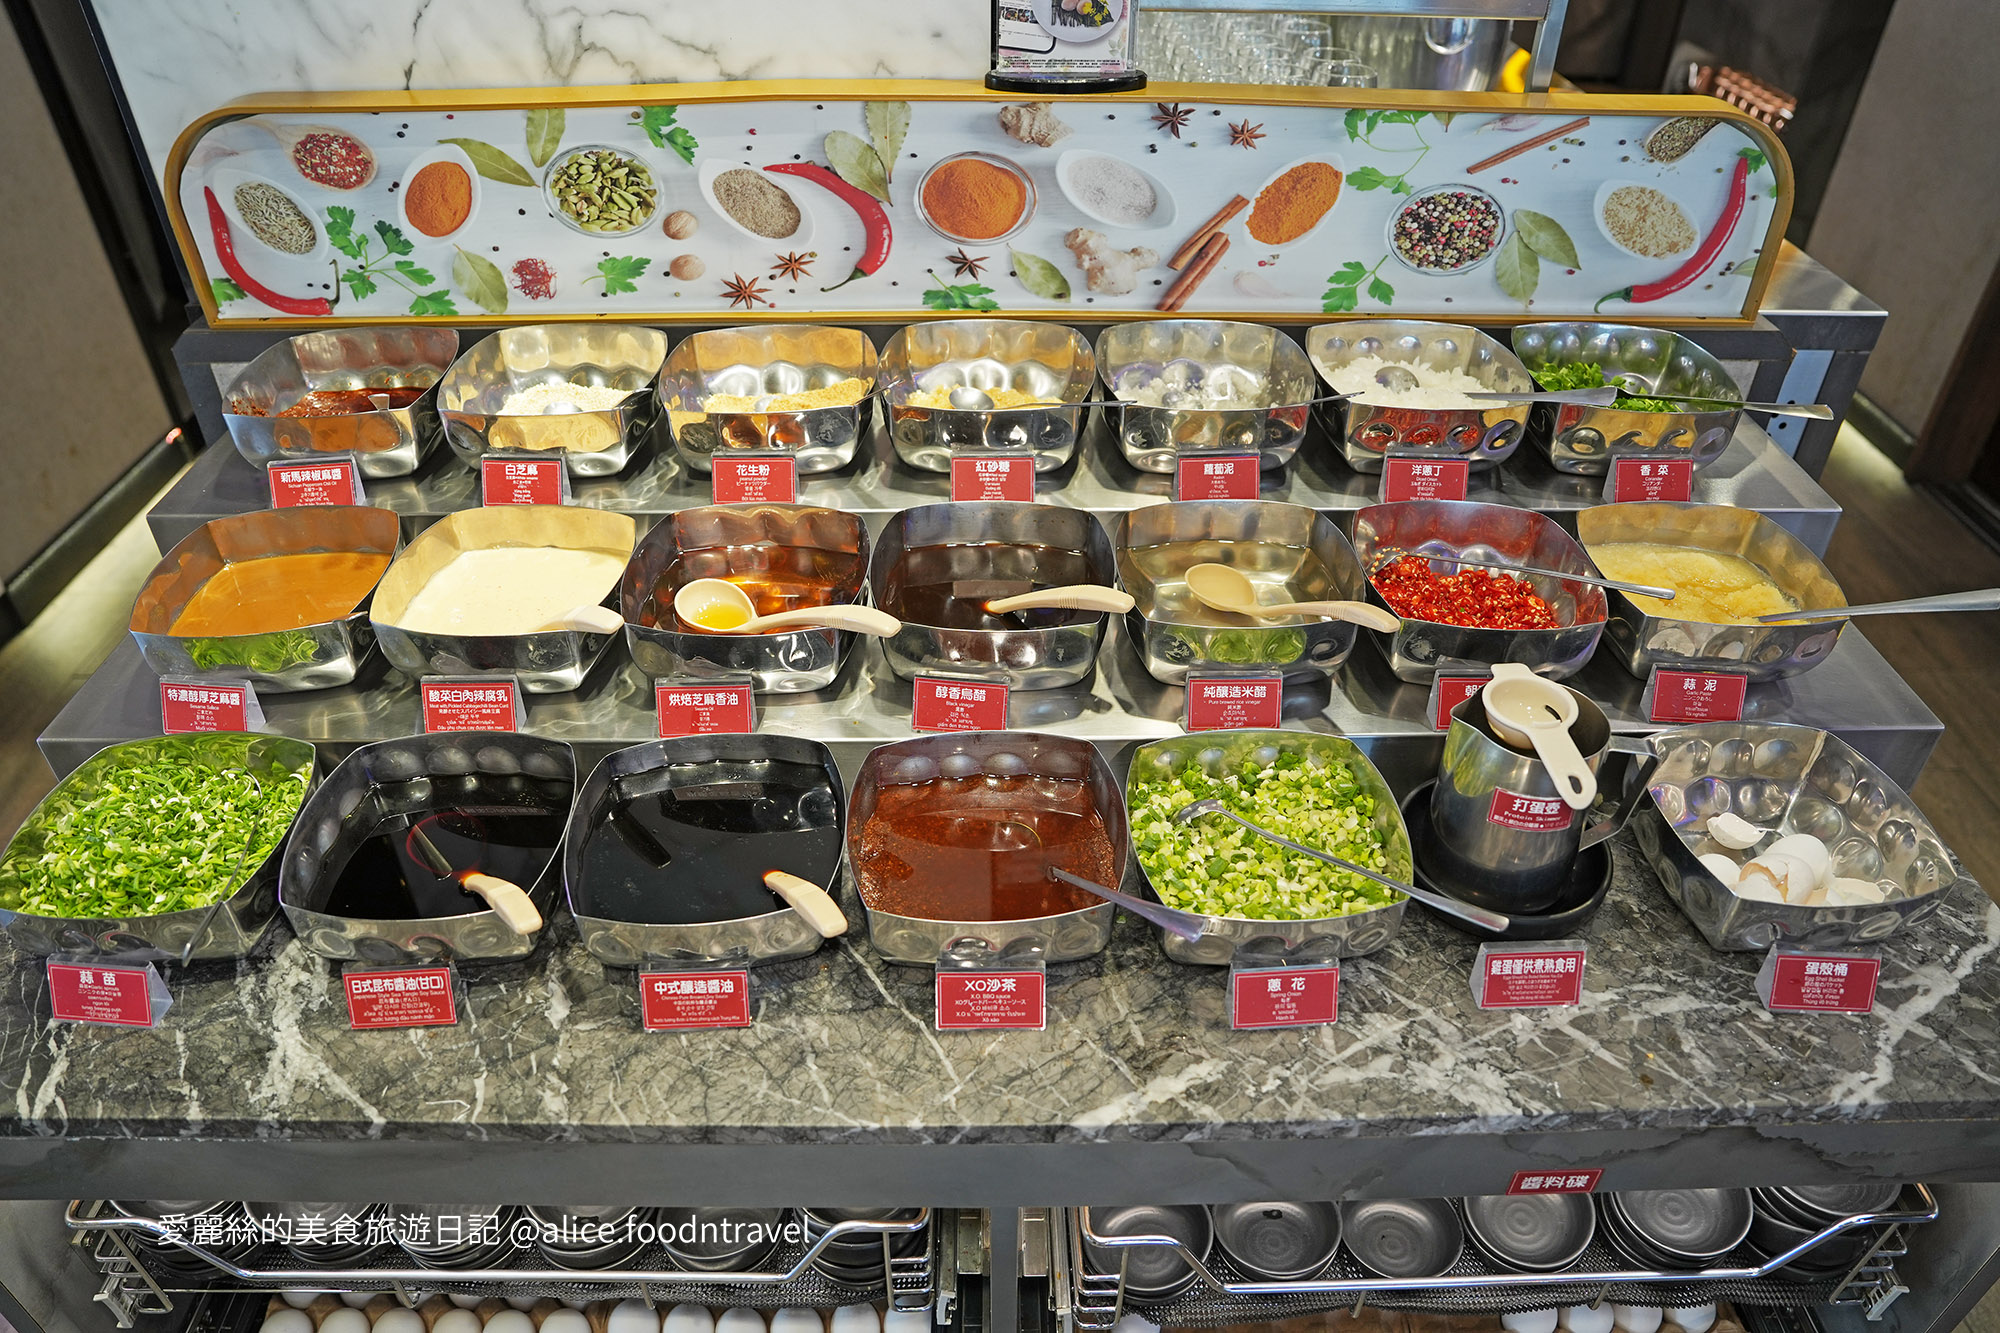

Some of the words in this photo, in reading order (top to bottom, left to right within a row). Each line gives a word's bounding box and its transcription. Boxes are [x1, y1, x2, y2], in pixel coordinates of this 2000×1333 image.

[505, 464, 538, 476] 白芝麻
[736, 464, 770, 476] 花生粉
[975, 460, 1010, 473] 紅砂糖
[1203, 463, 1234, 475] 蘿蔔泥
[1640, 464, 1669, 476] 香菜
[280, 468, 342, 483] 新馬辣椒麻醬
[1203, 685, 1267, 698] 純釀造米醋
[1683, 678, 1717, 691] 蒜泥
[167, 688, 240, 705] 特濃醇厚芝麻醬
[428, 689, 508, 702] 酸菜白肉辣腐乳
[668, 692, 739, 706] 烘焙芝麻香油
[935, 685, 986, 702] 醇香烏醋
[1512, 798, 1560, 815] 打蛋壺
[1504, 811, 1533, 821] Protein
[1490, 957, 1576, 975] 雞蛋僅供煮熟食用
[1804, 961, 1849, 976] 蛋殼桶
[79, 970, 116, 986] 蒜苗
[351, 976, 444, 994] 日式昆布醬油(甘口)
[964, 978, 1017, 992] XO沙茶
[654, 979, 734, 995] 中式釀造醬油
[1520, 1175, 1590, 1190] 醬料碟
